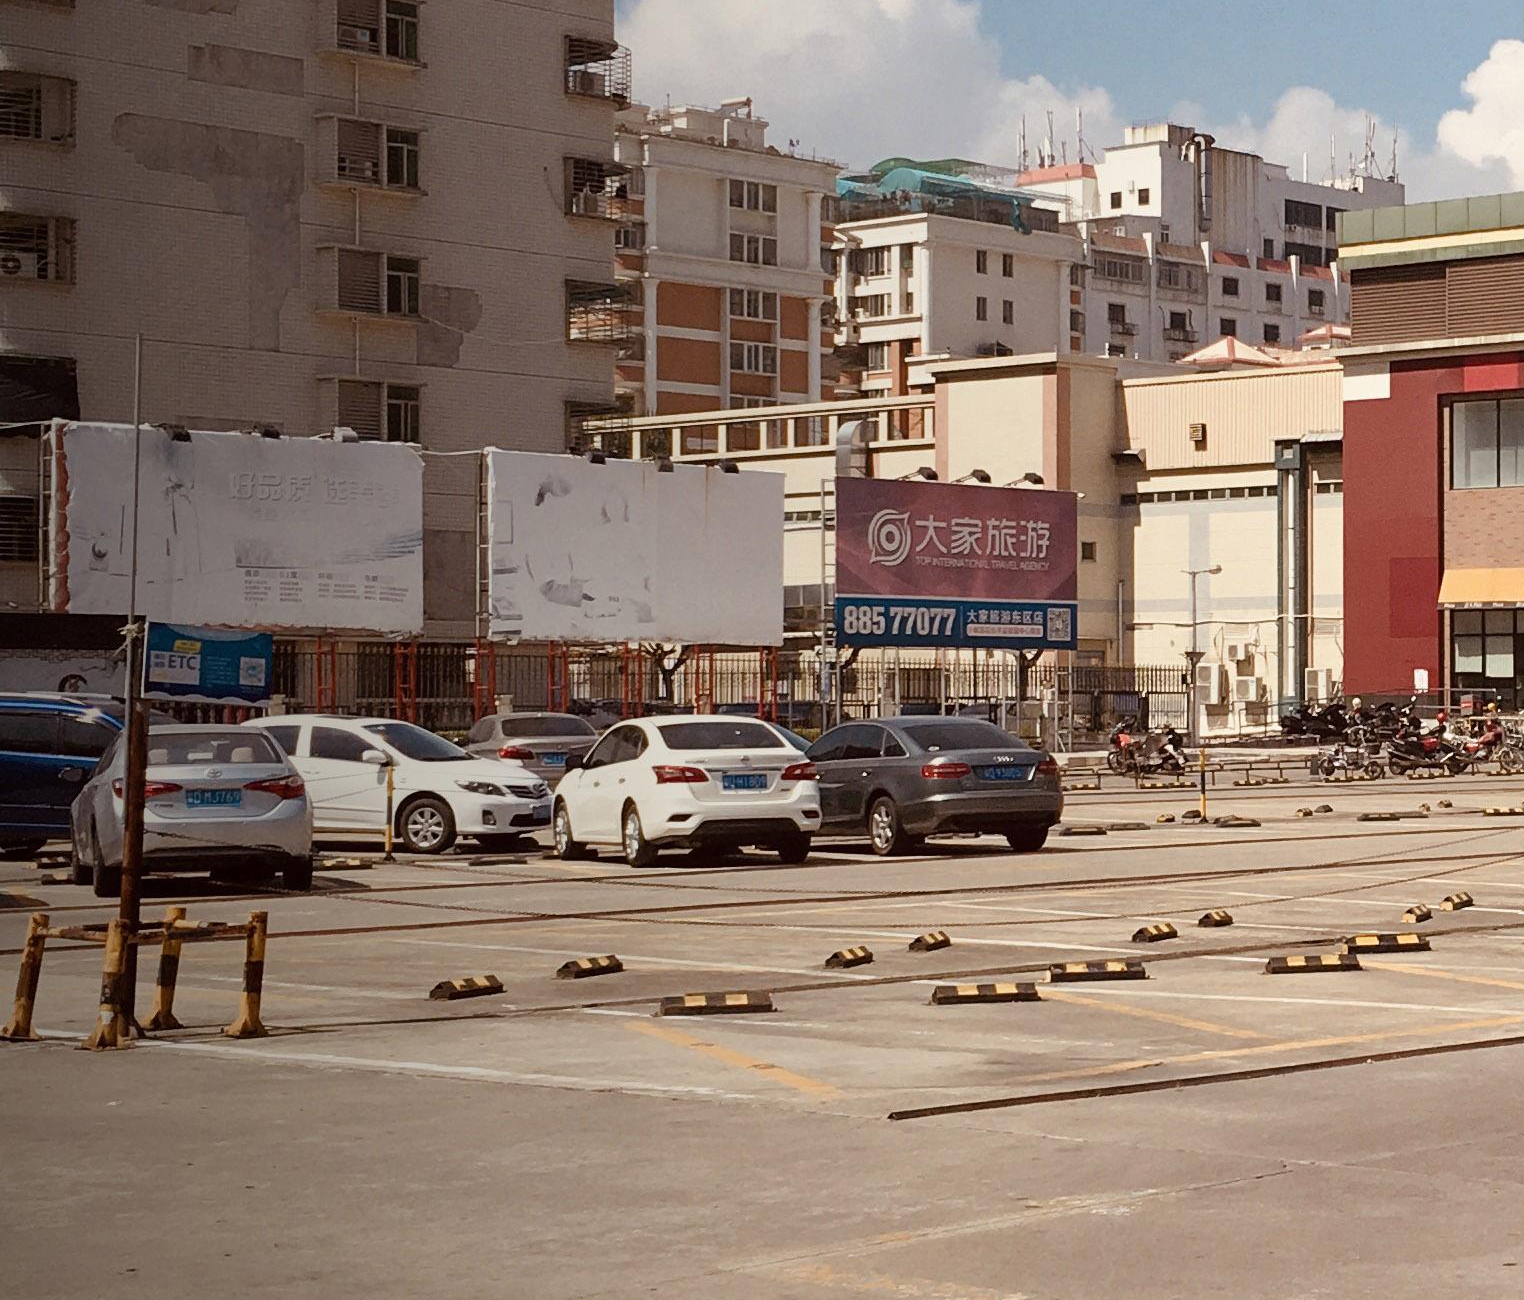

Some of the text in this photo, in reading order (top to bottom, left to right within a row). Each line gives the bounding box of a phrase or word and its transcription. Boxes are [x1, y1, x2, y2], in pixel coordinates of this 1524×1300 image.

[914, 514, 1051, 559] 大家旅游
[844, 605, 957, 637] 885 77077
[168, 654, 197, 670] ETC
